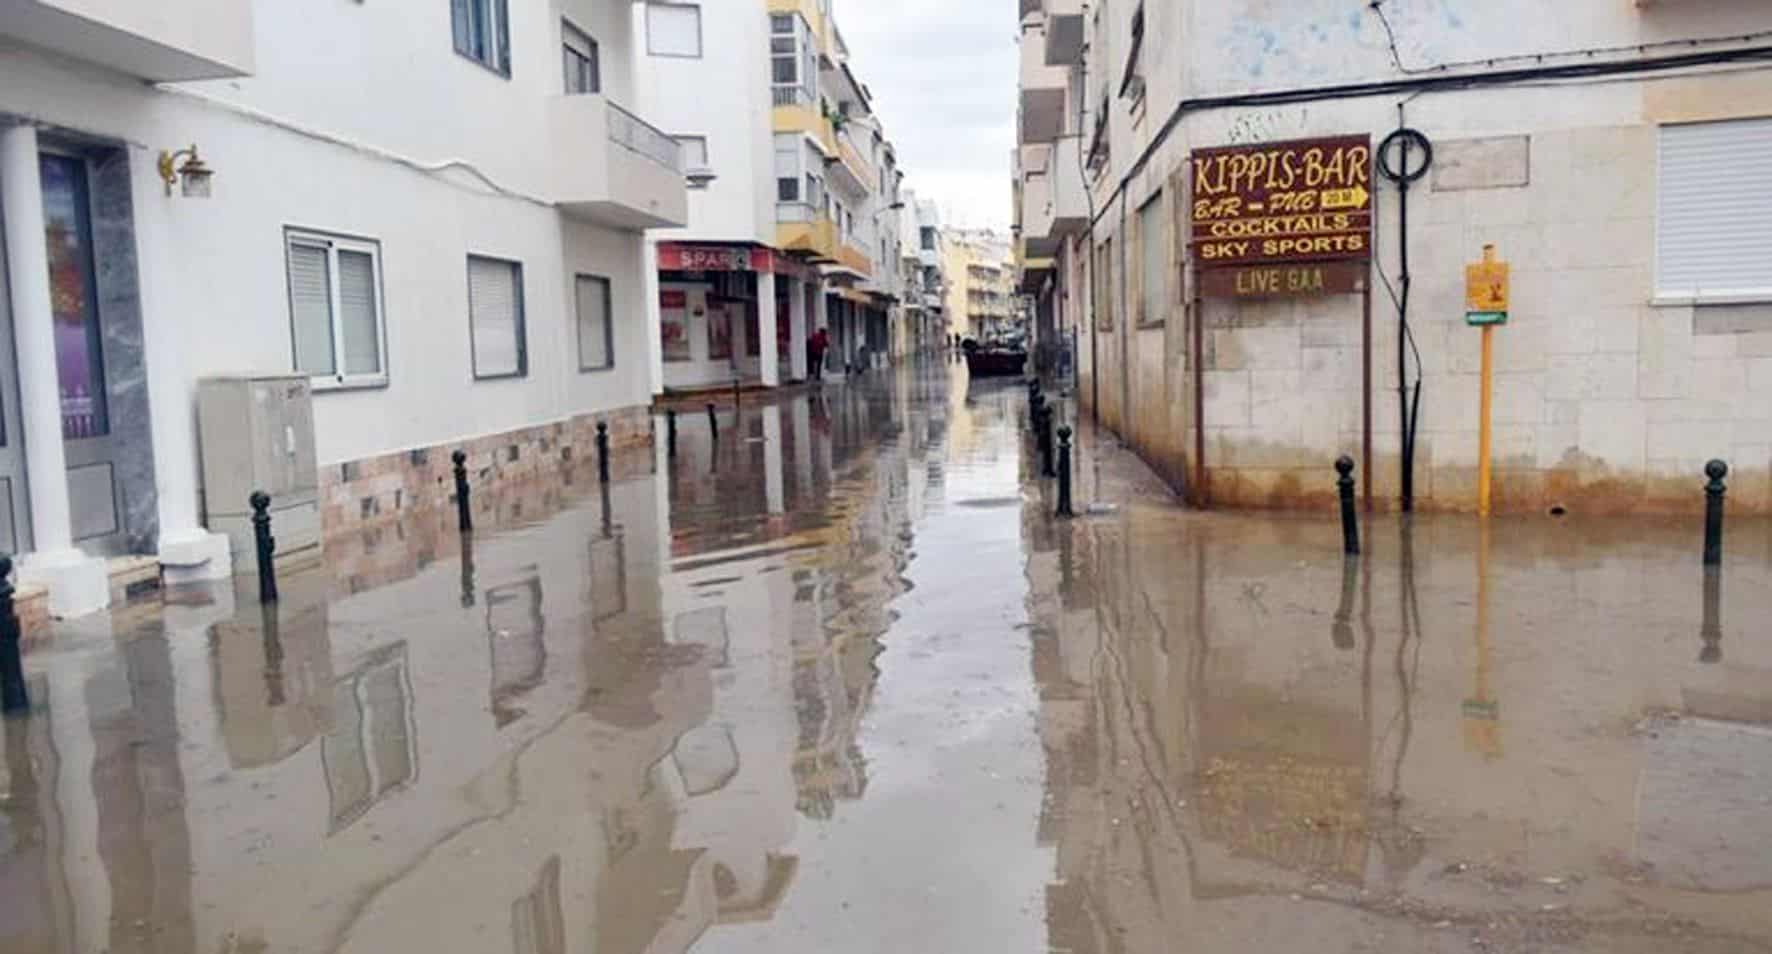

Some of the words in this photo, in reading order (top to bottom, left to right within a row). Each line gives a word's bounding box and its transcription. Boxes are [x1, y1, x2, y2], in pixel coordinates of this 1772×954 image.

[1194, 197, 1242, 219] BAR
[1210, 214, 1350, 237] COCKTAILS
[1202, 242, 1249, 259] SKY
[1263, 235, 1363, 255] SPORTS
[1236, 270, 1280, 293] LIVE
